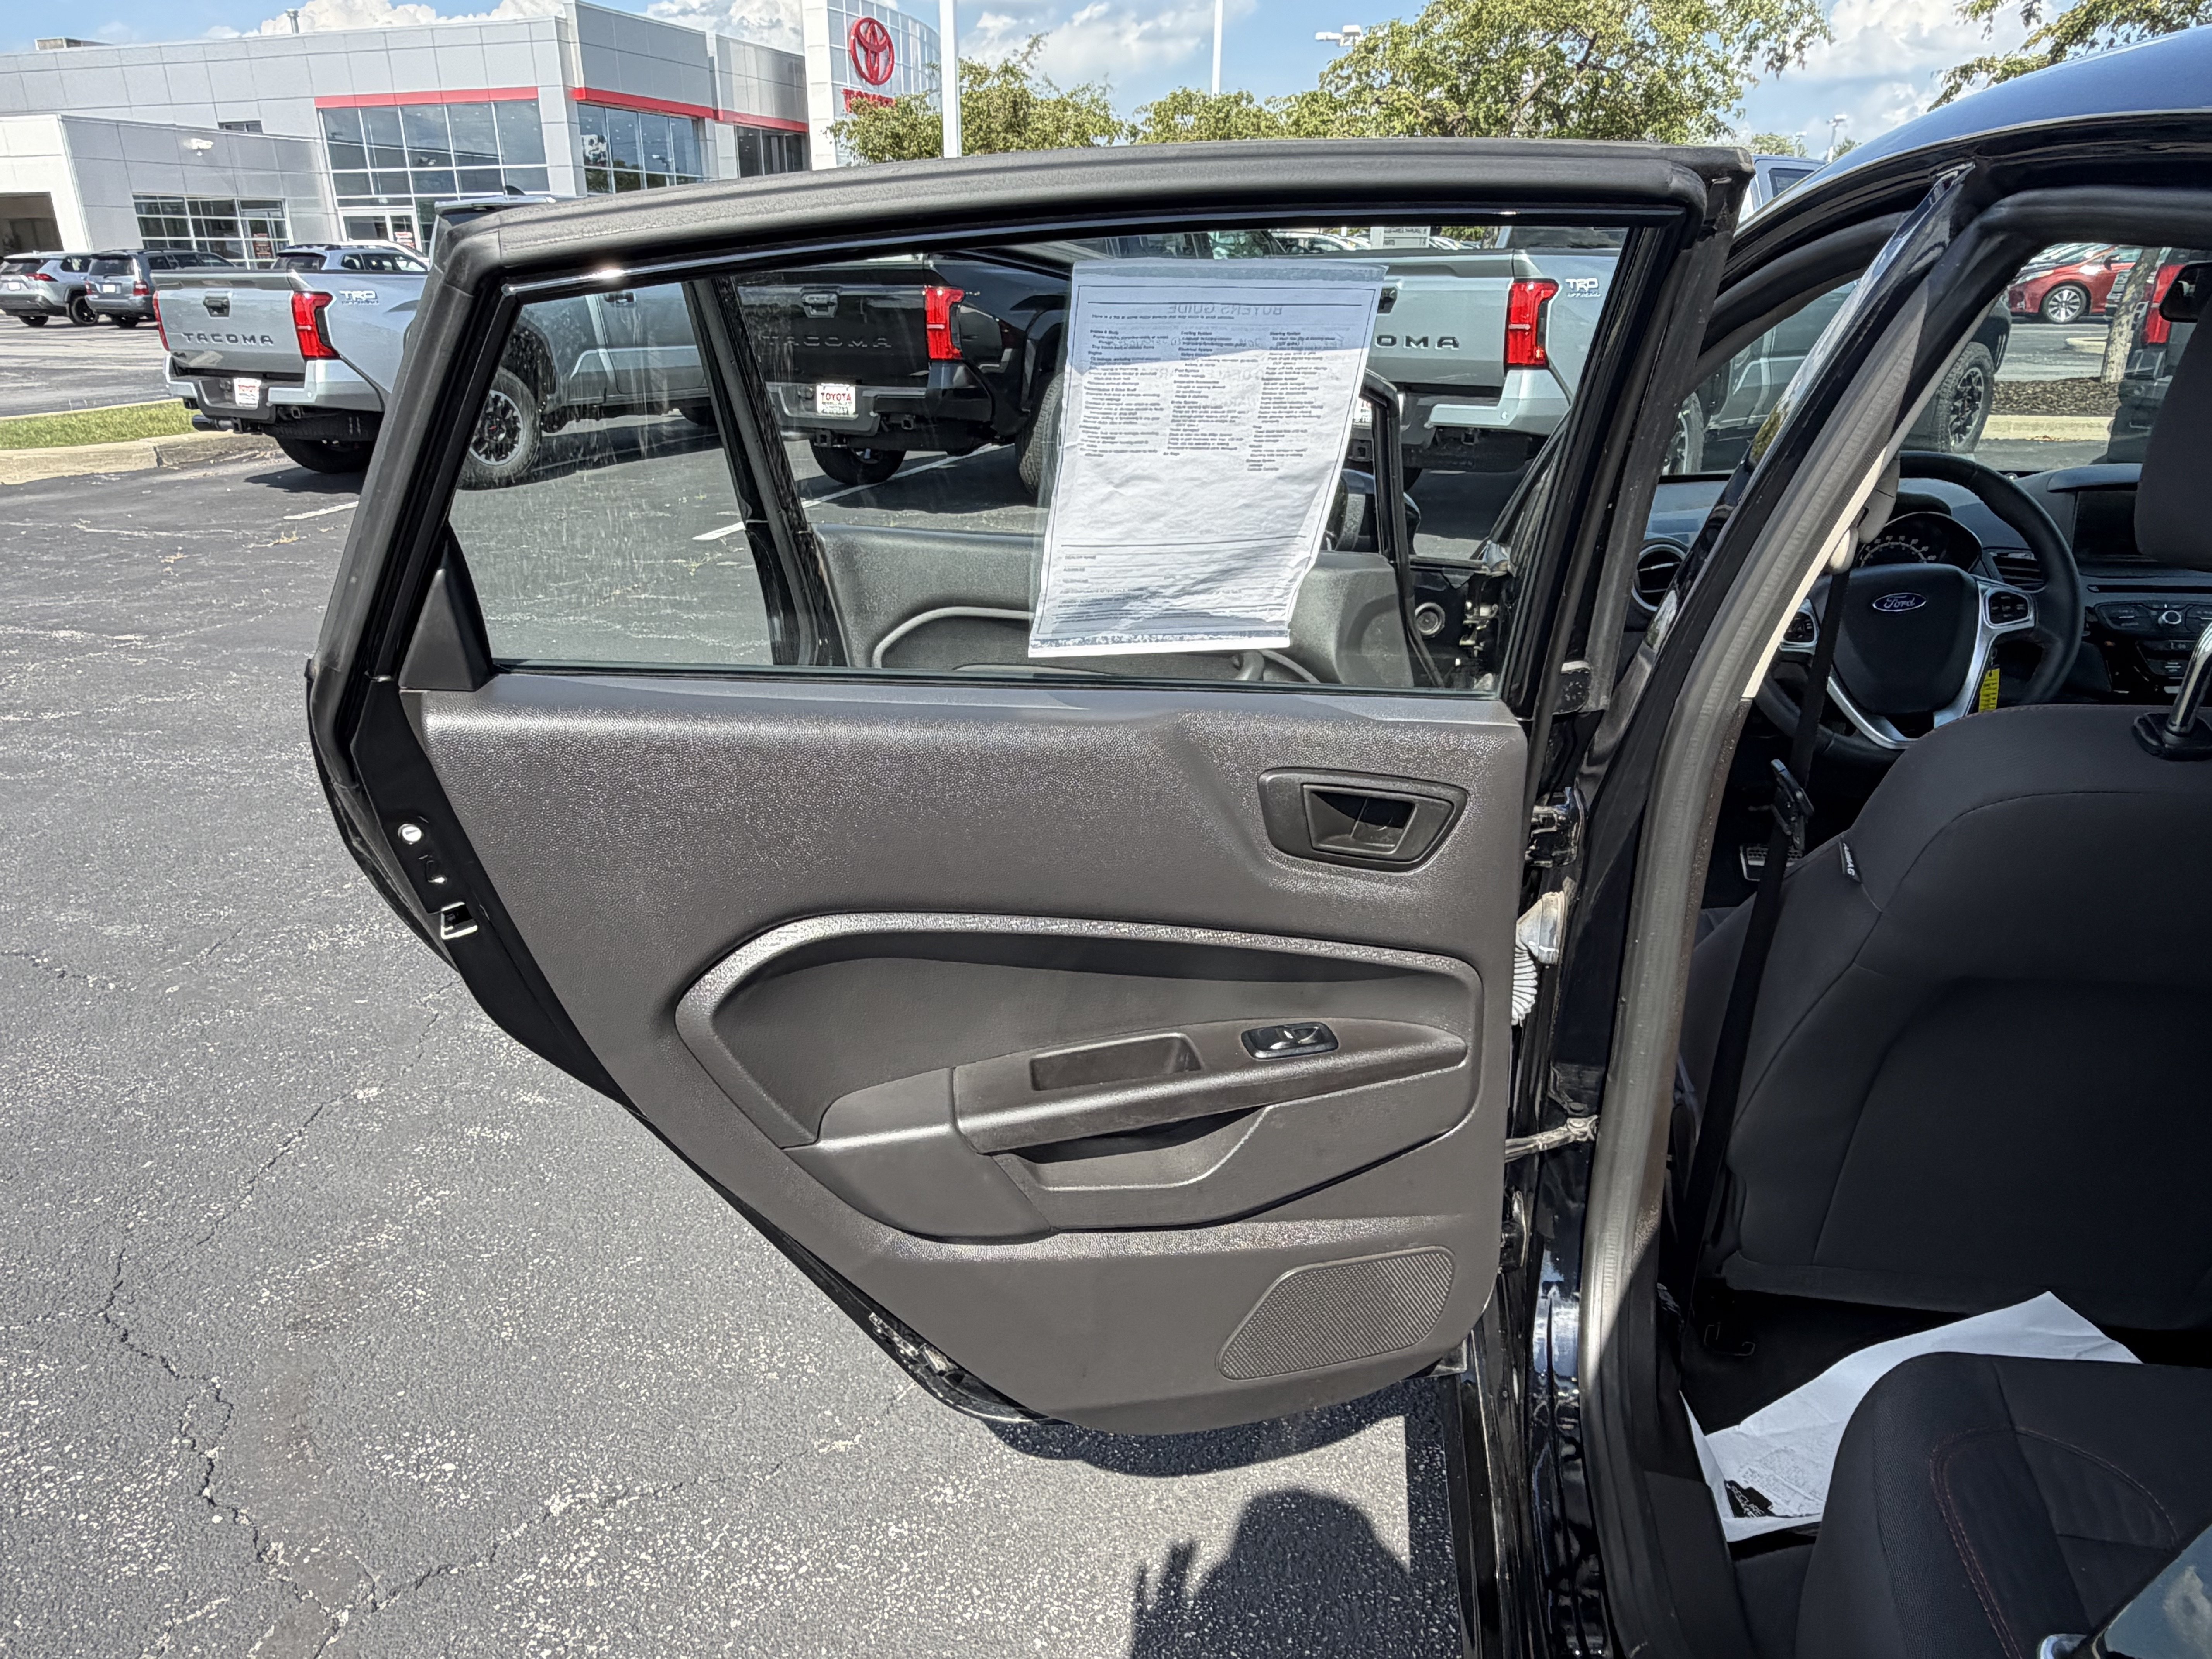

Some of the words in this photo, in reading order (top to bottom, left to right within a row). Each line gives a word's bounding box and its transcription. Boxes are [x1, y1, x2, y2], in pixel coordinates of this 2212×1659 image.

[1565, 278, 1598, 292] TRD
[339, 290, 376, 301] TRD
[181, 332, 274, 345] TACOMA
[821, 392, 851, 401] TOYOTA
[1883, 595, 1916, 609] Ford
